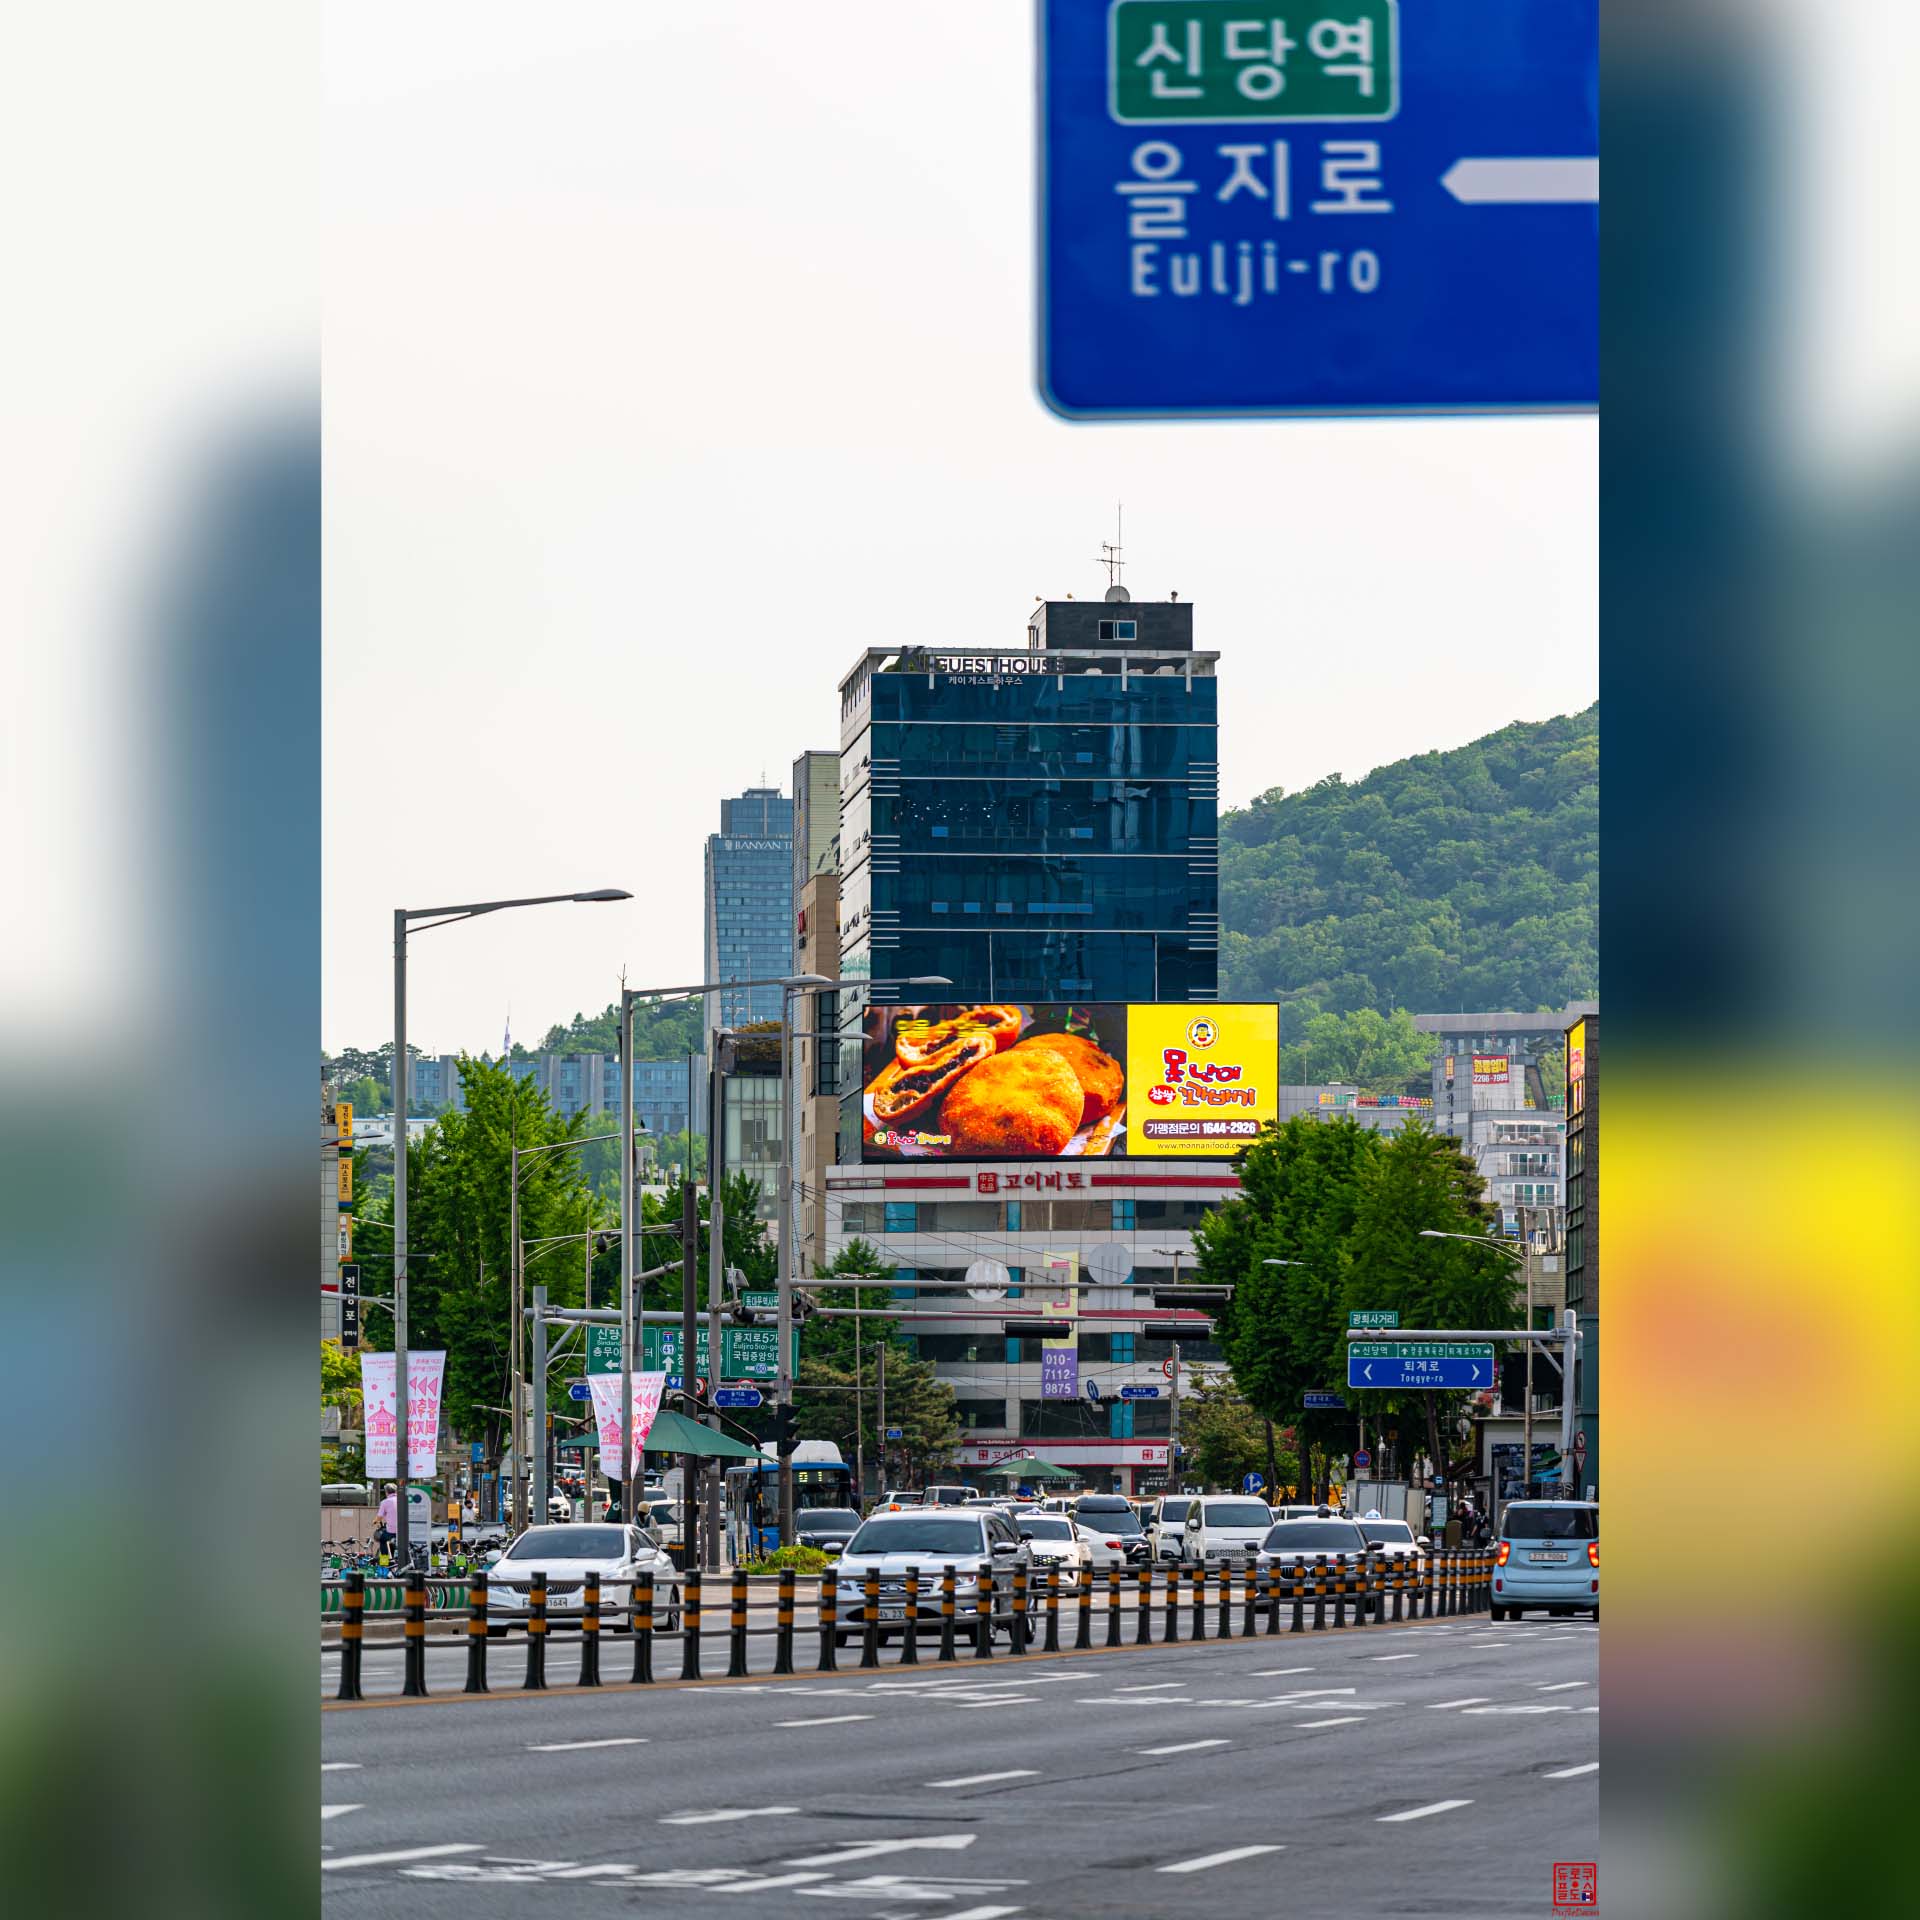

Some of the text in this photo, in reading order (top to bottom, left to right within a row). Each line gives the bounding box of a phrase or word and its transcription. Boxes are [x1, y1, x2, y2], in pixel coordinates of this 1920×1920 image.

[1136, 17, 1376, 101] 신당역
[1115, 140, 1393, 240] 을지로
[1131, 241, 1381, 306] Eulji-ro
[948, 676, 1024, 685] 케이 게스트하우스
[736, 841, 781, 849] BANYAN
[1163, 1049, 1242, 1083] 못난이
[1147, 1122, 1256, 1135] 가맹점문의 1644-2926
[1003, 1171, 1087, 1191] 고이비토
[1353, 1314, 1396, 1325] 광희사거리
[733, 1332, 778, 1343] 을지로5가
[1362, 1346, 1388, 1356] 신당역
[1046, 1353, 1072, 1365] 010-
[1404, 1361, 1440, 1372] 퇴계로
[1045, 1368, 1076, 1380] 7112-
[1400, 1374, 1444, 1384] Toegye-ro
[1045, 1383, 1072, 1395] 9875
